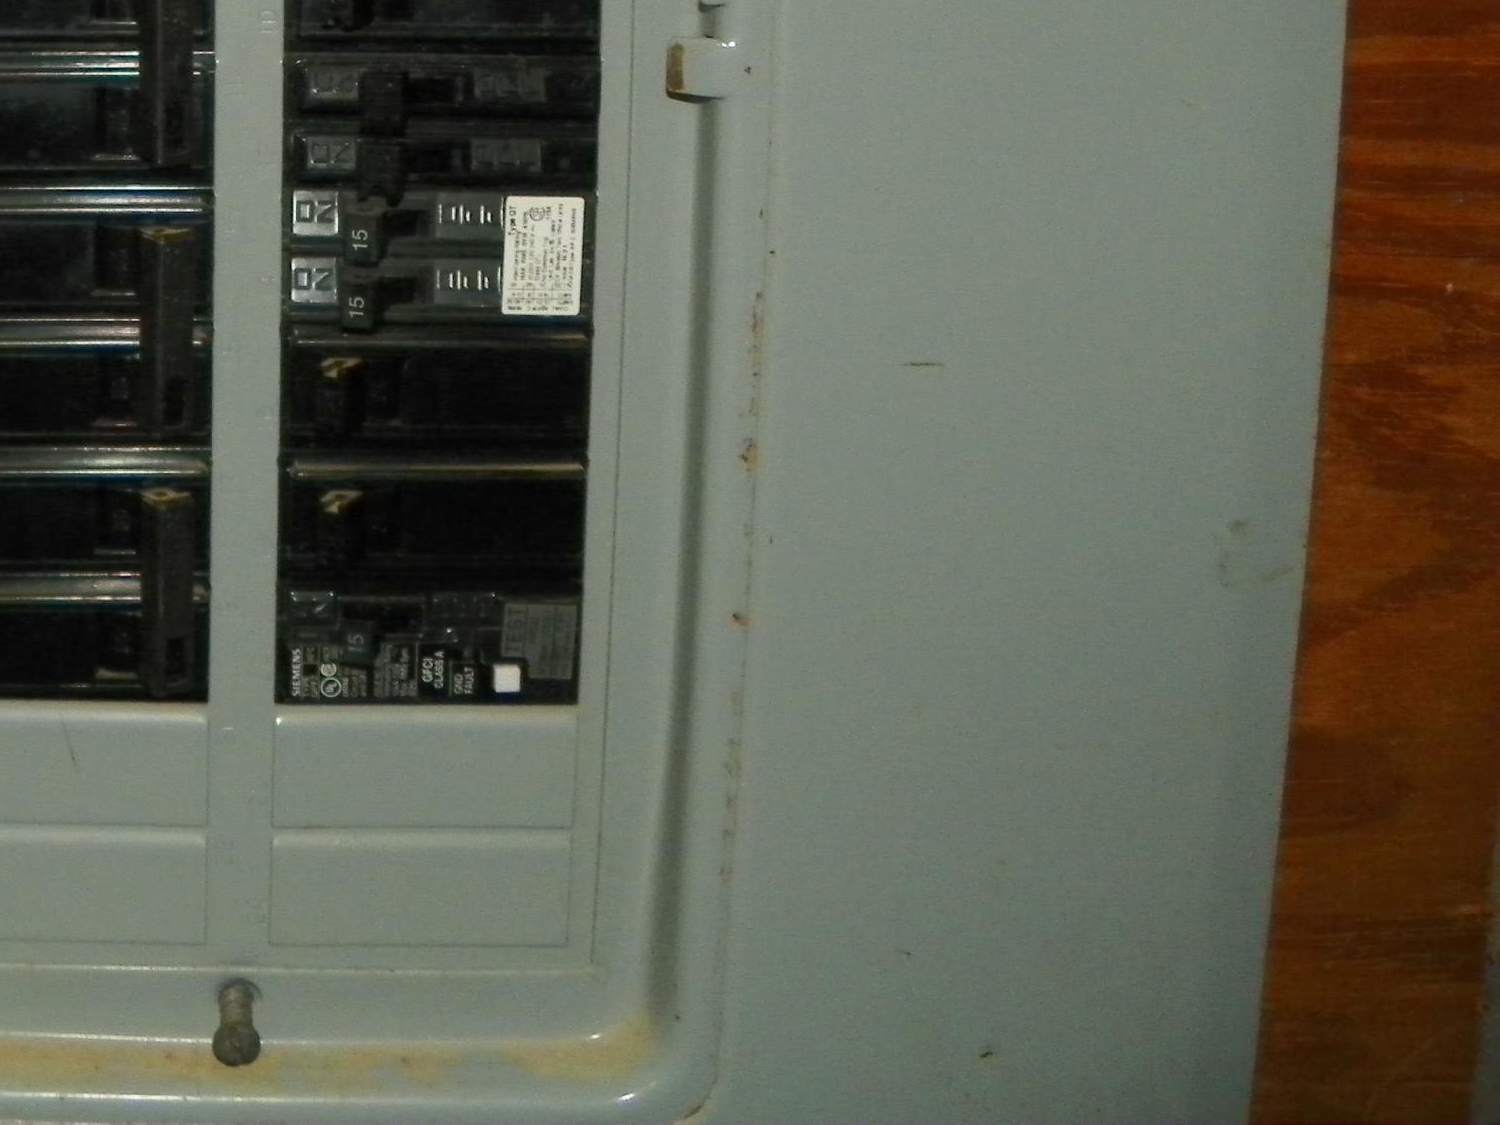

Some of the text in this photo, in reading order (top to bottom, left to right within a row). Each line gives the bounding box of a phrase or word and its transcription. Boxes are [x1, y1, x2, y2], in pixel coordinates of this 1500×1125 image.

[352, 229, 368, 251] 15
[349, 297, 365, 318] 15
[292, 649, 301, 697] SIEMENS
